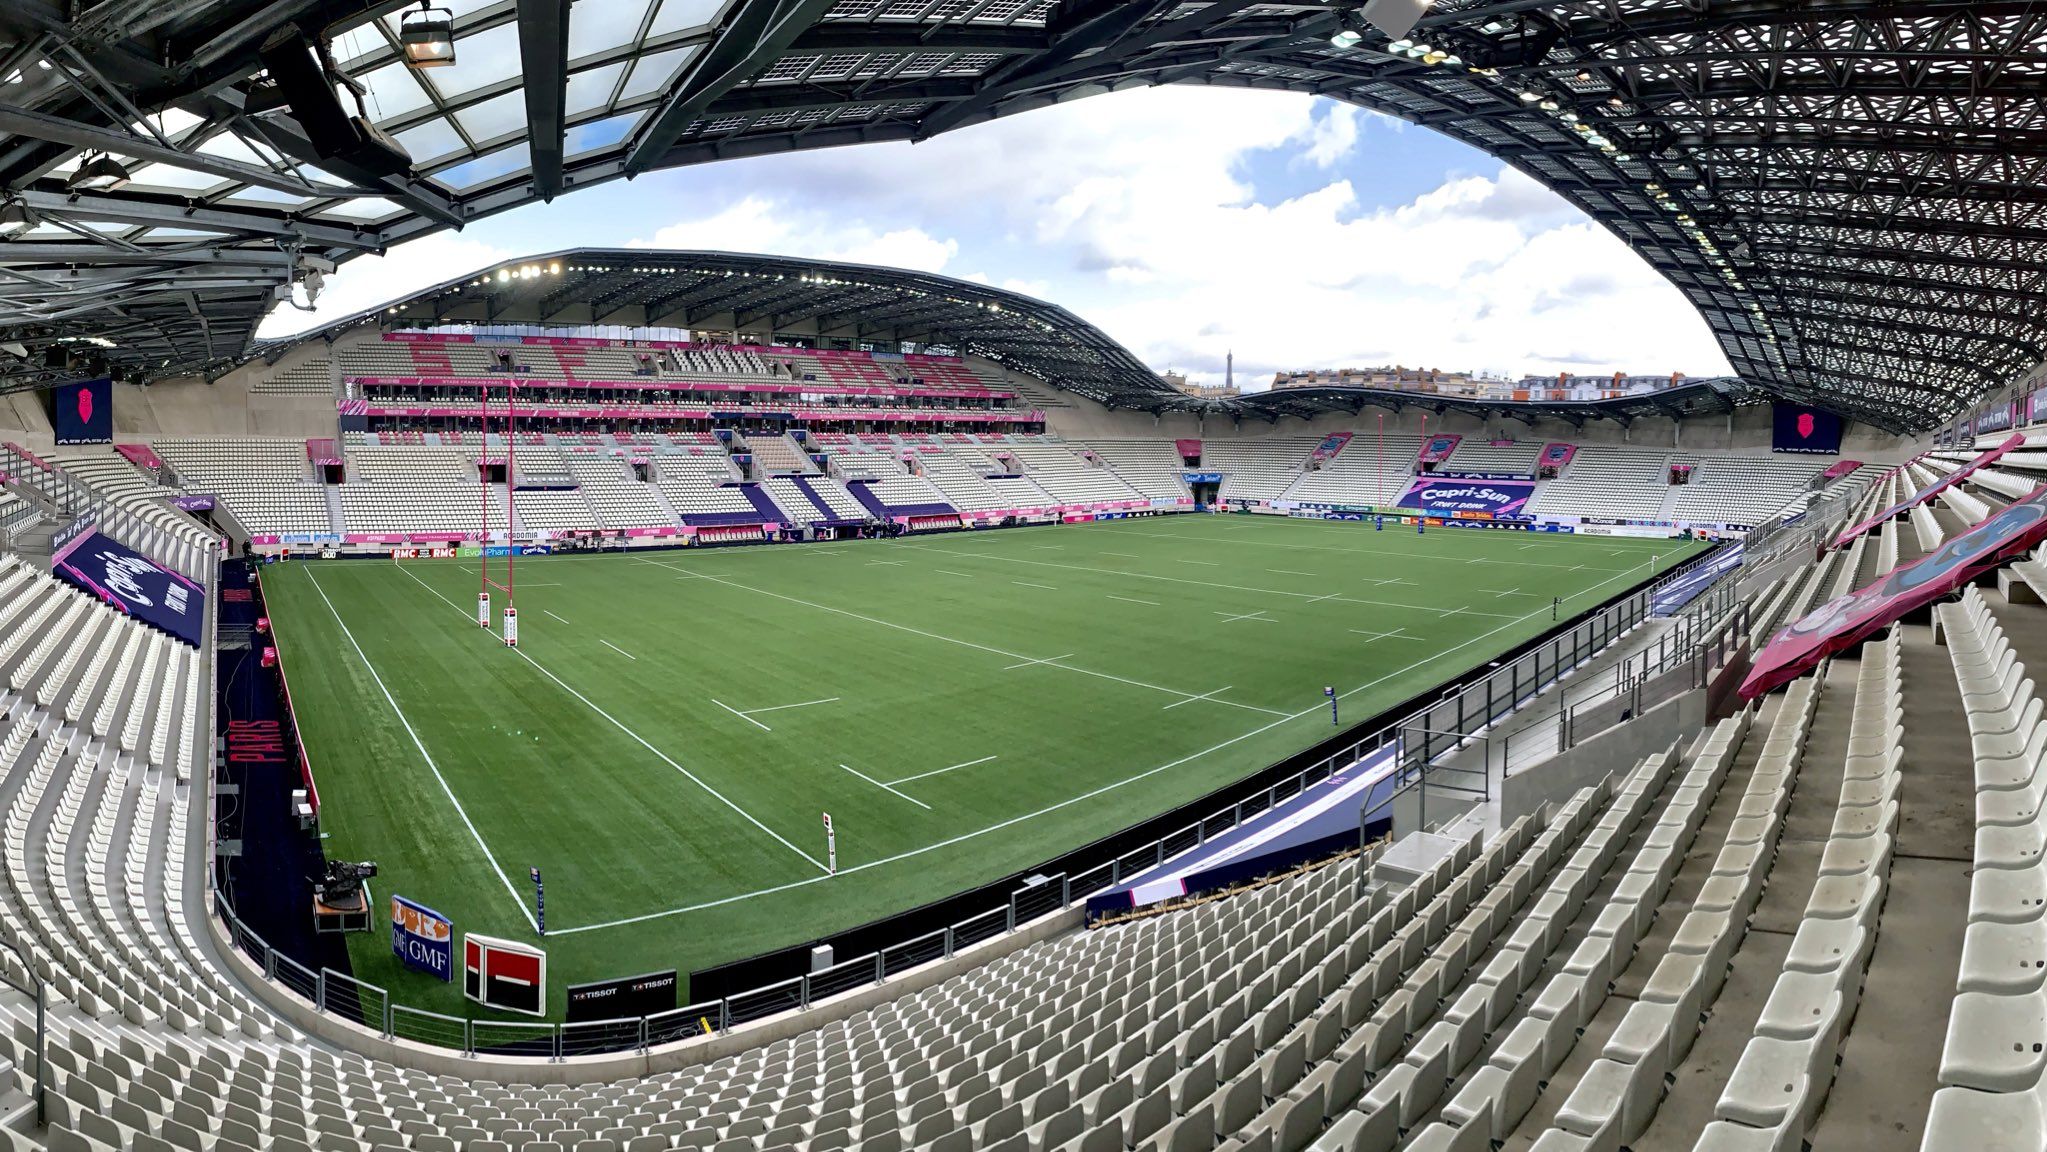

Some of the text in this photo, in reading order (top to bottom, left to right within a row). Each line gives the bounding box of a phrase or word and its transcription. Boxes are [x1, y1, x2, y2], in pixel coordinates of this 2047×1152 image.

[1420, 487, 1512, 503] Capri-Sun
[1431, 500, 1488, 510] FRUIT DRINK
[393, 549, 416, 558] RMC
[433, 548, 455, 558] RMC
[229, 720, 288, 762] PARIS
[393, 928, 405, 952] GMF
[409, 940, 447, 971] GMF
